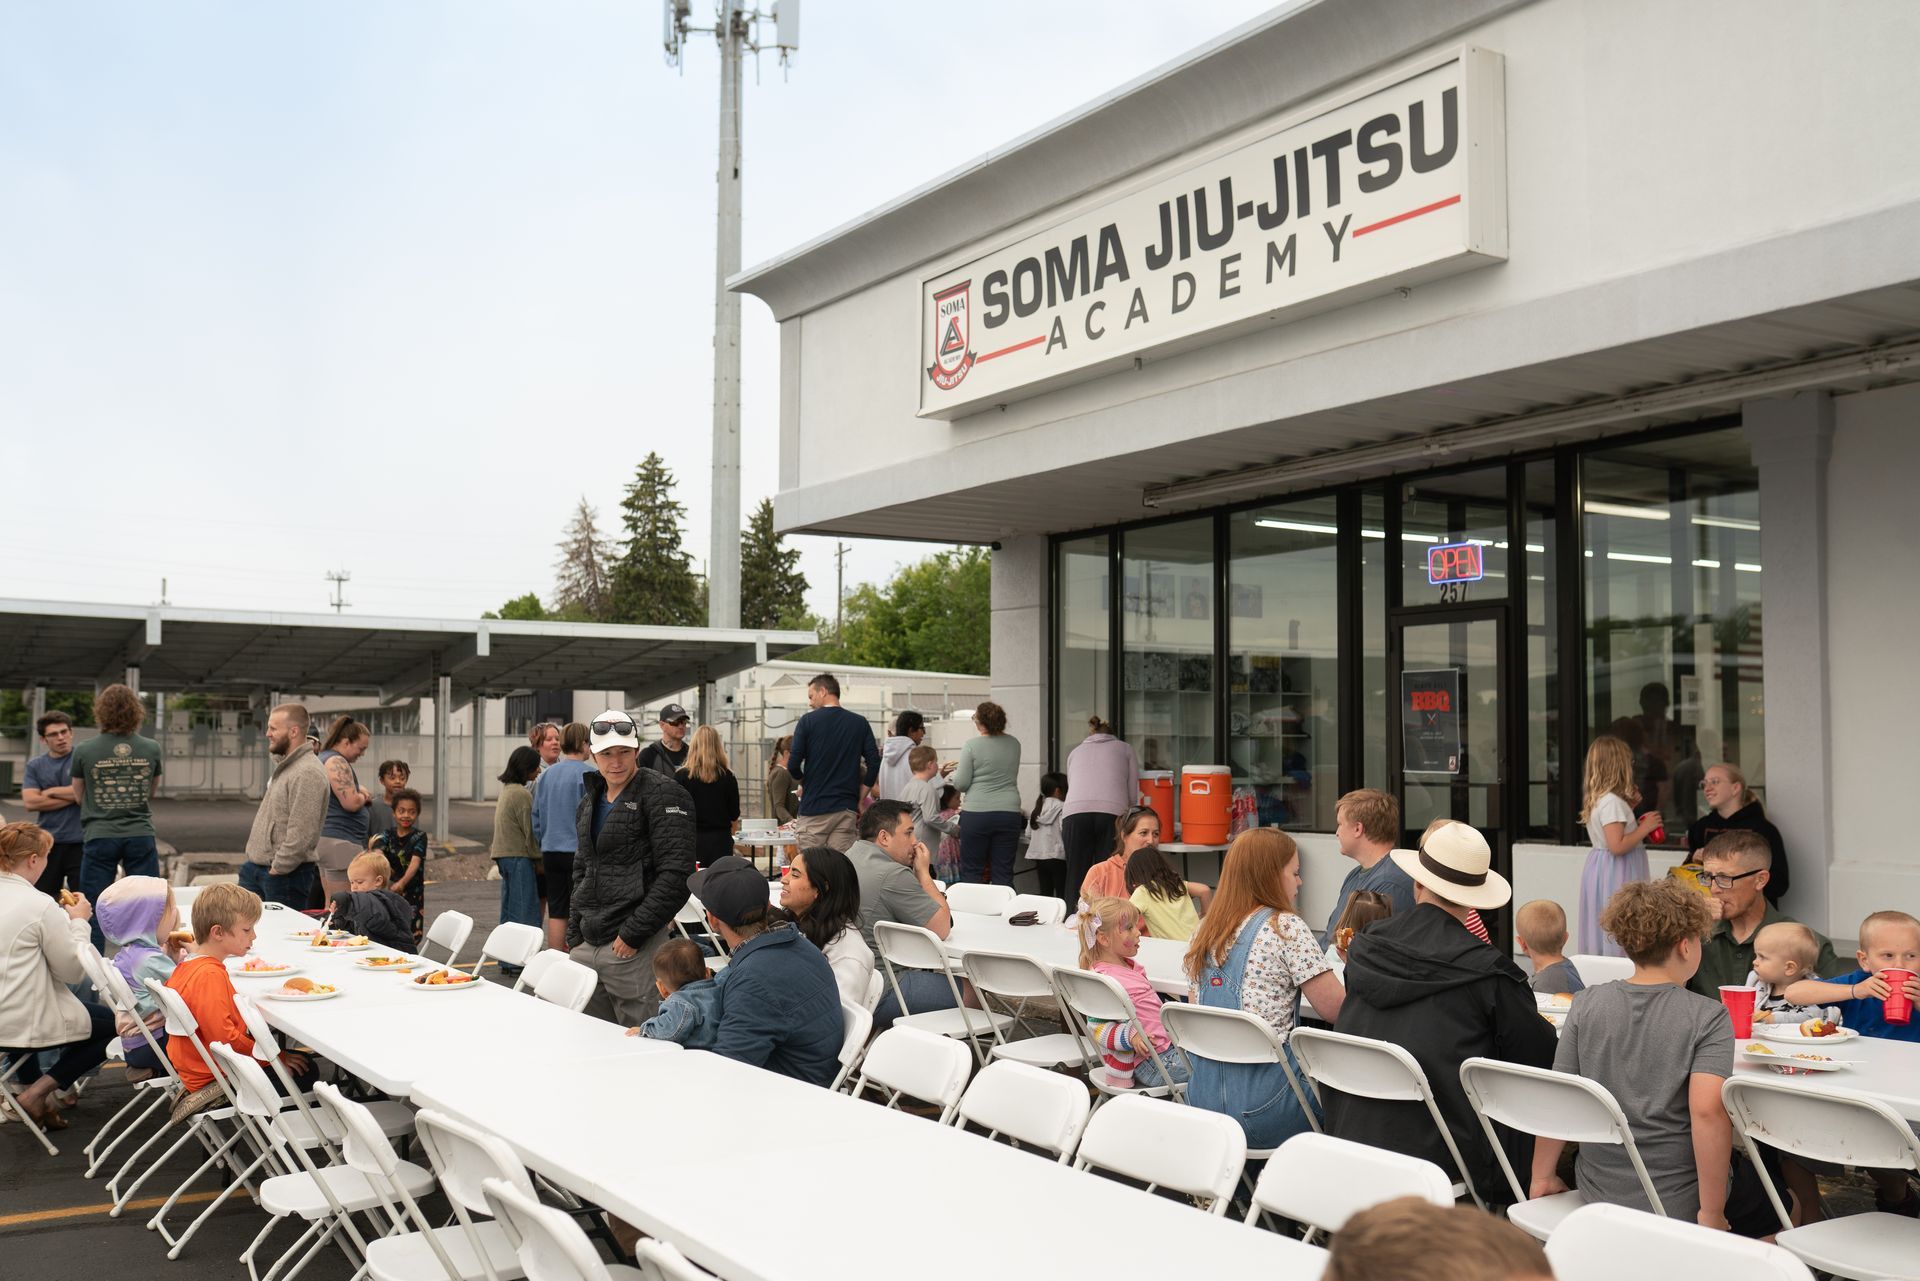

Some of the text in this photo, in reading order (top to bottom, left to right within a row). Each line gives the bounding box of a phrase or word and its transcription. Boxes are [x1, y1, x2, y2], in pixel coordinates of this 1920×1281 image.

[982, 86, 1458, 330] SOMA JIU-JITSU
[1045, 213, 1353, 355] ACADEMY
[941, 298, 965, 317] SOMA
[1430, 545, 1481, 580] OPEN
[1440, 581, 1468, 603] 257
[1411, 691, 1450, 712] BBQ
